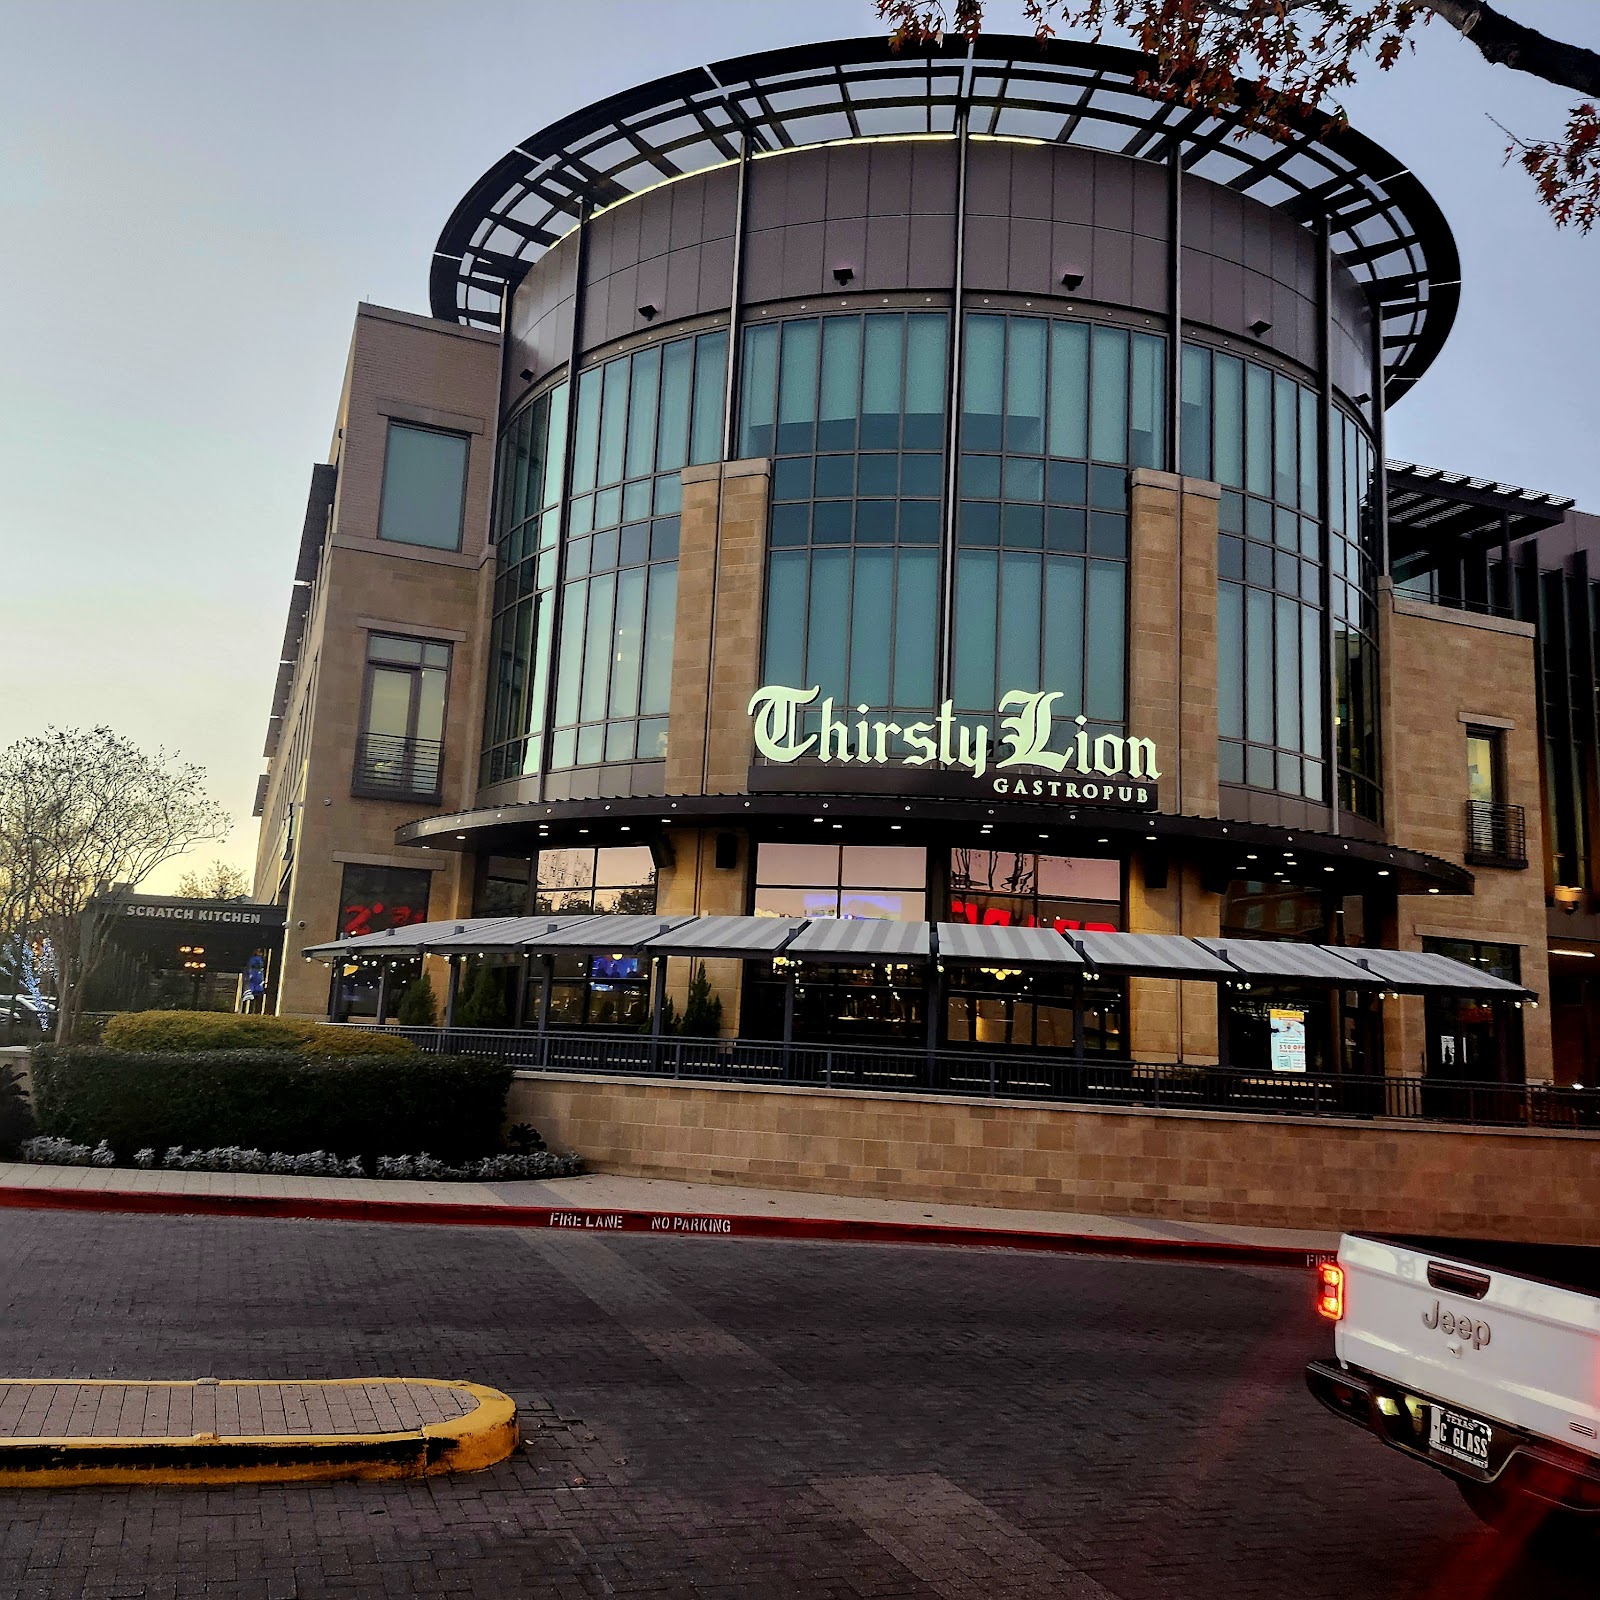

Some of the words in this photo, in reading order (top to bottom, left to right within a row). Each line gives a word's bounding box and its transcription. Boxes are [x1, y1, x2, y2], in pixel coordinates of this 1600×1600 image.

[747, 685, 989, 779] Thirsty
[996, 690, 1163, 780] Lion
[993, 777, 1149, 803] GASTROPUB
[126, 905, 194, 920] SCRATCH
[198, 909, 261, 924] KITCHEN
[549, 1212, 582, 1227] FIRE
[585, 1215, 623, 1229] LANE
[651, 1216, 670, 1230] NO
[673, 1217, 731, 1233] PARKING
[1306, 1254, 1336, 1267] FIRE
[1421, 1299, 1491, 1350] Jeep
[1445, 1414, 1474, 1431] TEXAS
[1452, 1427, 1488, 1458] GLASS
